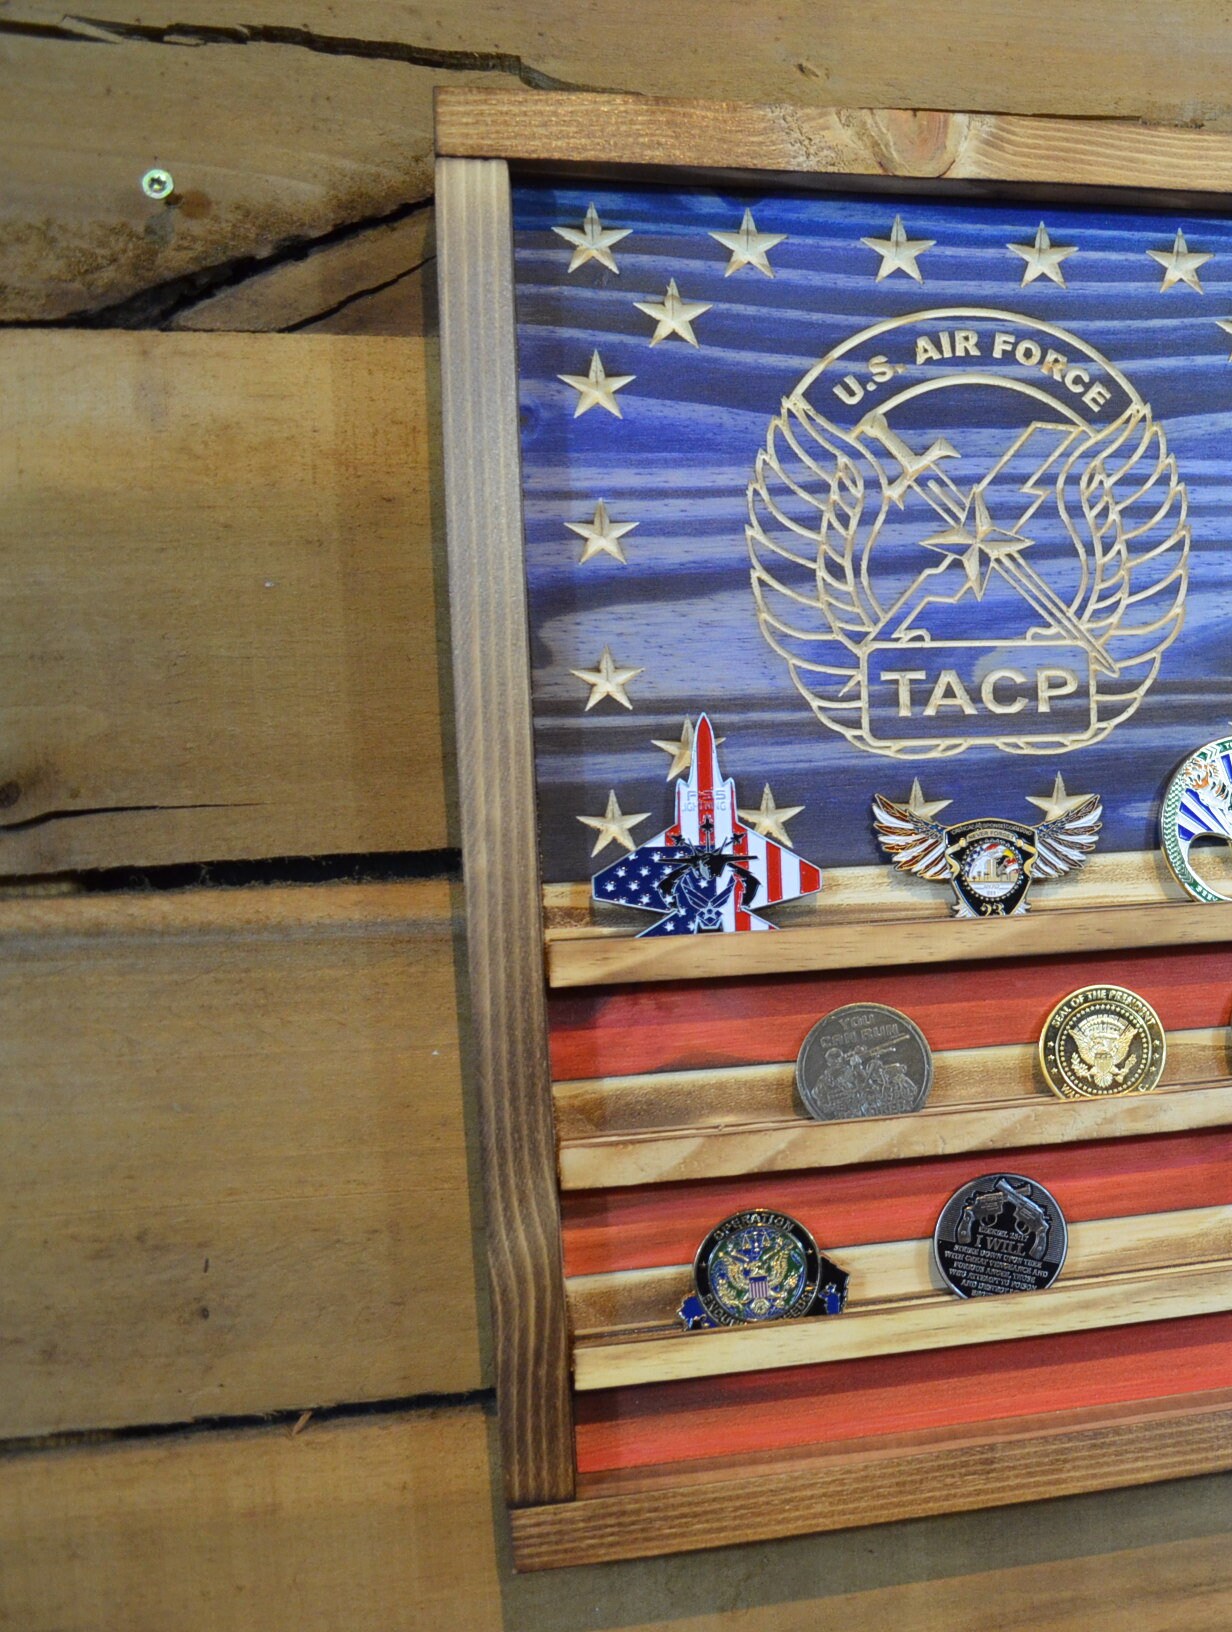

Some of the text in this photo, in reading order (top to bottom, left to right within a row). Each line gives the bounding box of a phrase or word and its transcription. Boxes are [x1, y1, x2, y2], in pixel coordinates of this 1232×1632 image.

[832, 330, 1113, 414] U.S. AIR FORCE
[880, 668, 1079, 717] TACP
[968, 830, 1014, 840] NEVER FORGET
[1051, 990, 1156, 1028] SEAL OF THE PRESIDENT
[839, 1014, 875, 1031] YOU
[820, 1023, 899, 1048] CAN RUN
[714, 1214, 795, 1240] OPERATION
[974, 1234, 1026, 1256] I WILL
[980, 1249, 1003, 1259] DOWN
[1003, 1255, 1023, 1264] UPON
[945, 1251, 964, 1259] WITH
[965, 1255, 988, 1265] GREAT
[1032, 1270, 1048, 1278] AND
[948, 1268, 967, 1277] WHO
[961, 1279, 977, 1287] AND
